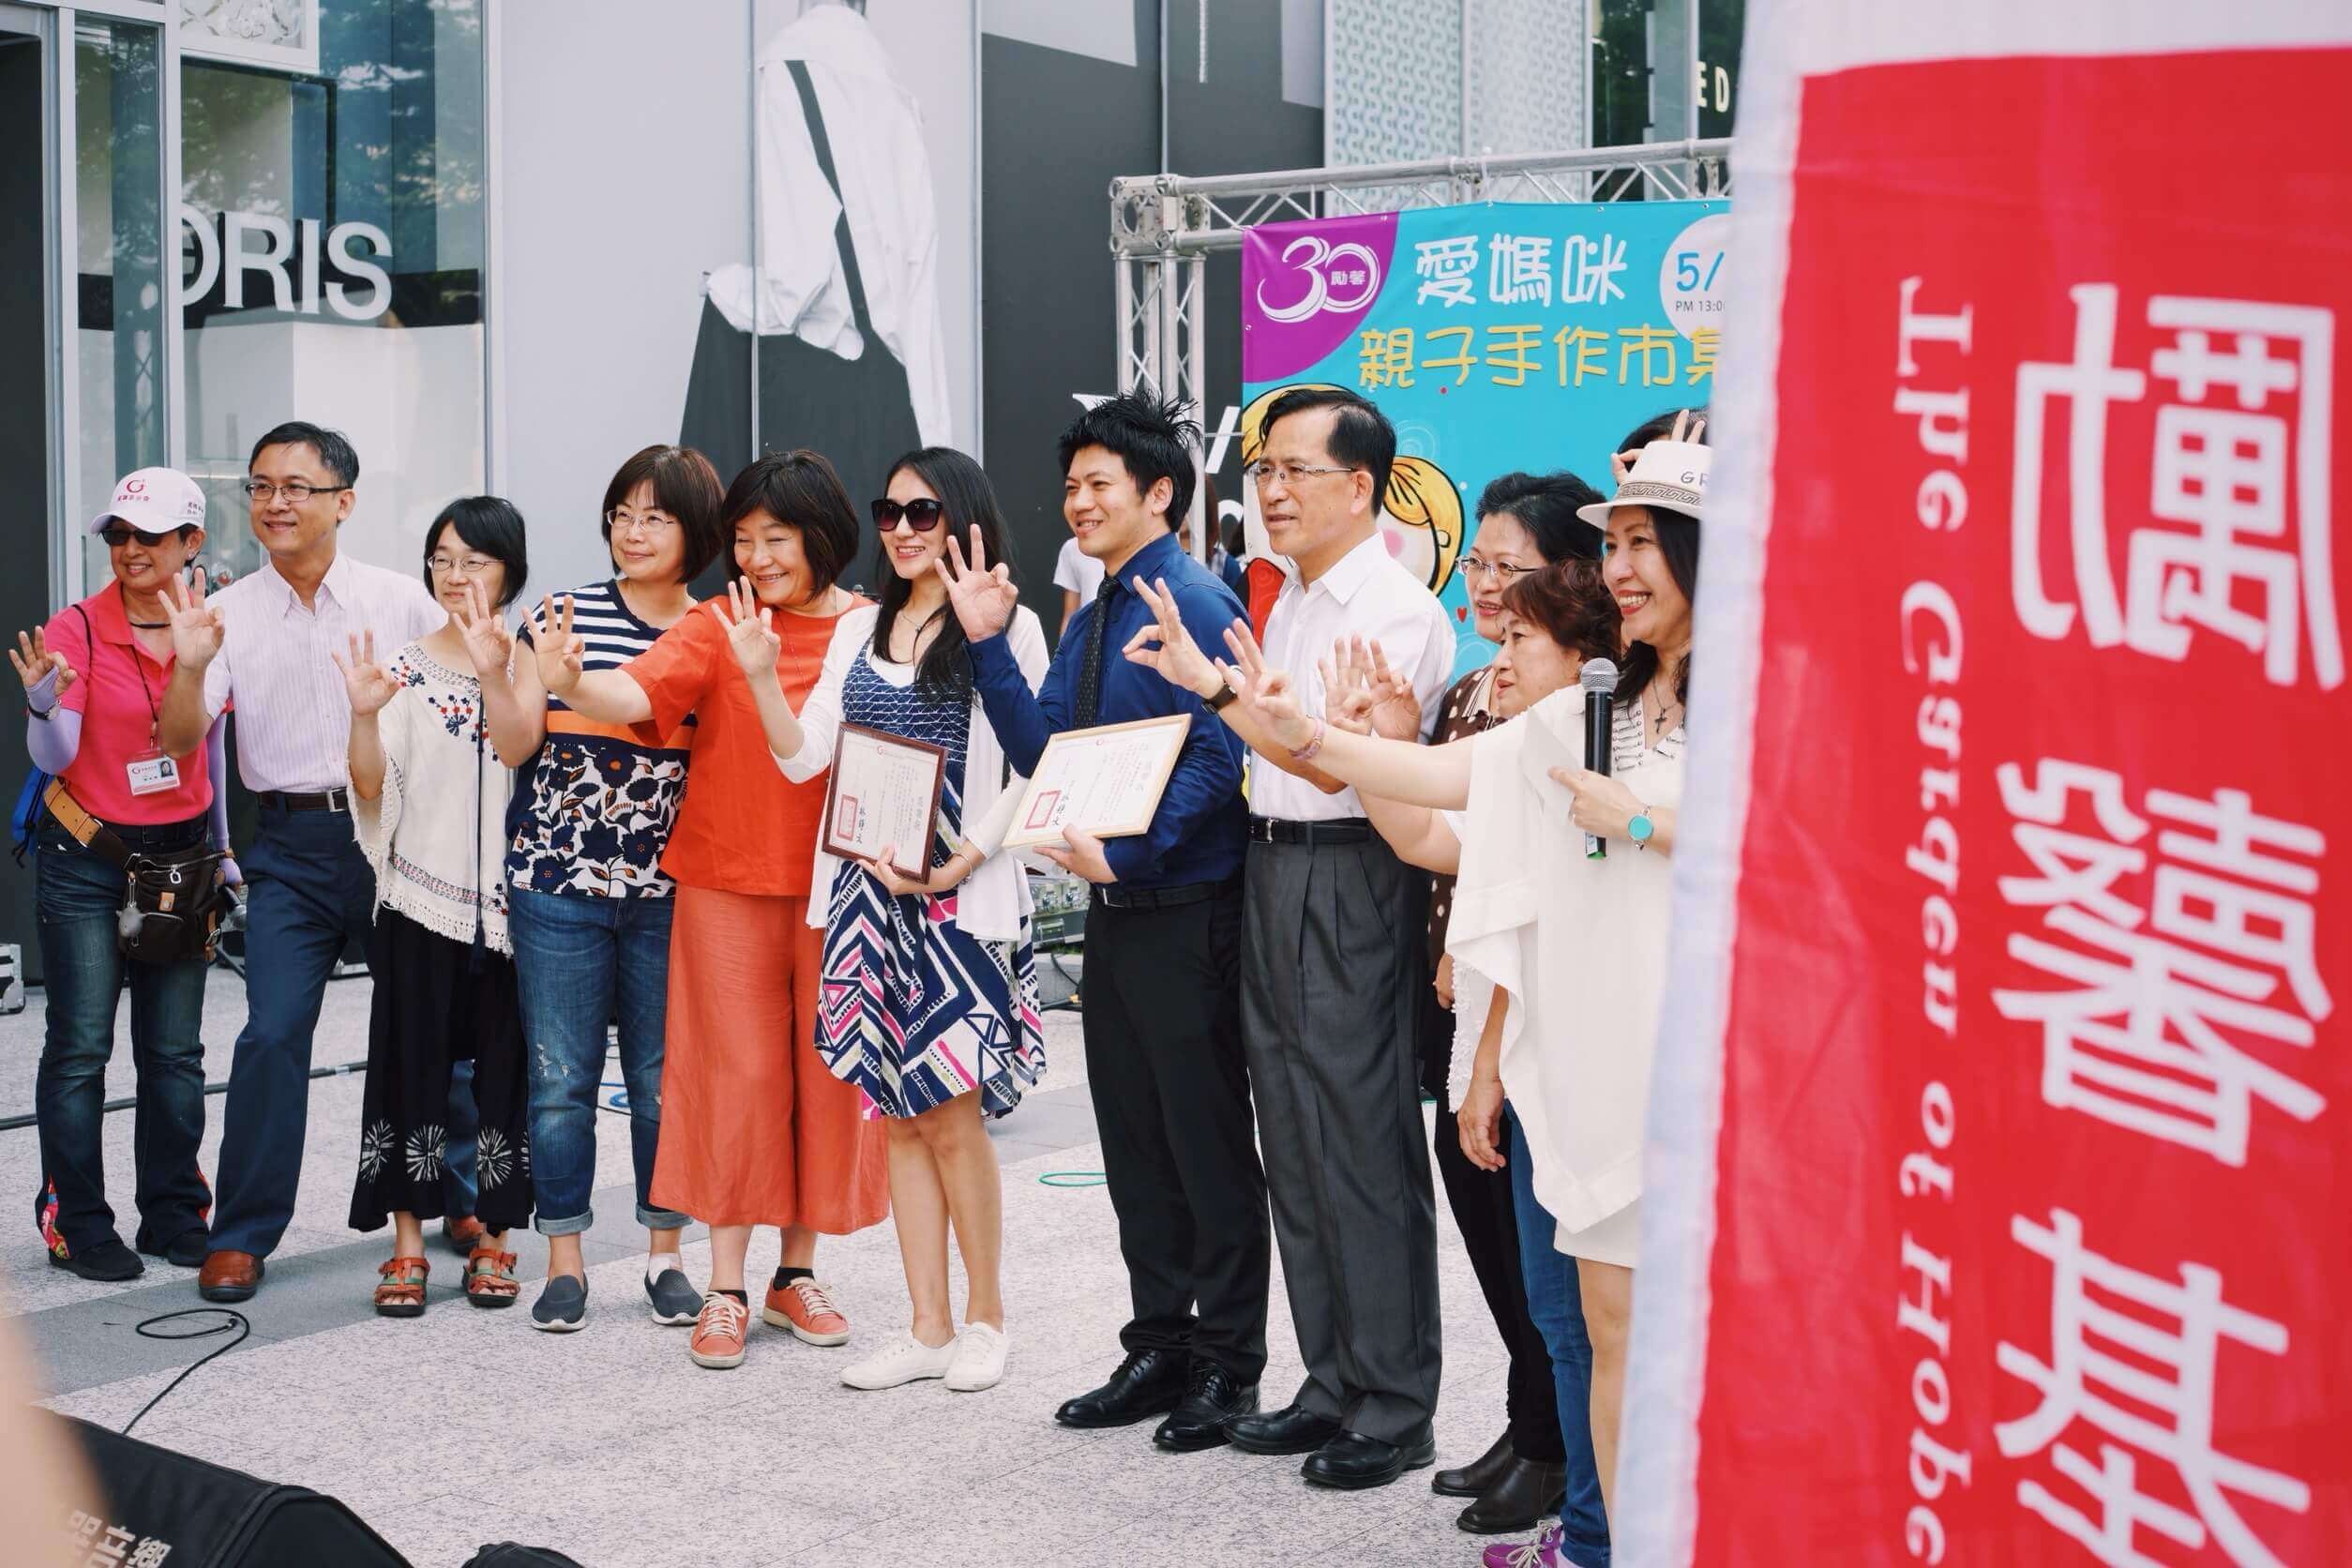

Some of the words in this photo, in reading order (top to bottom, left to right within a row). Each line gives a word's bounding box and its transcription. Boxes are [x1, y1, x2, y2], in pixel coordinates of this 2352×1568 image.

[1257, 236, 1380, 324] 30
[1413, 232, 1629, 308] 愛媽咪
[1675, 300, 1694, 312] PM
[1698, 300, 1726, 312] 13:0
